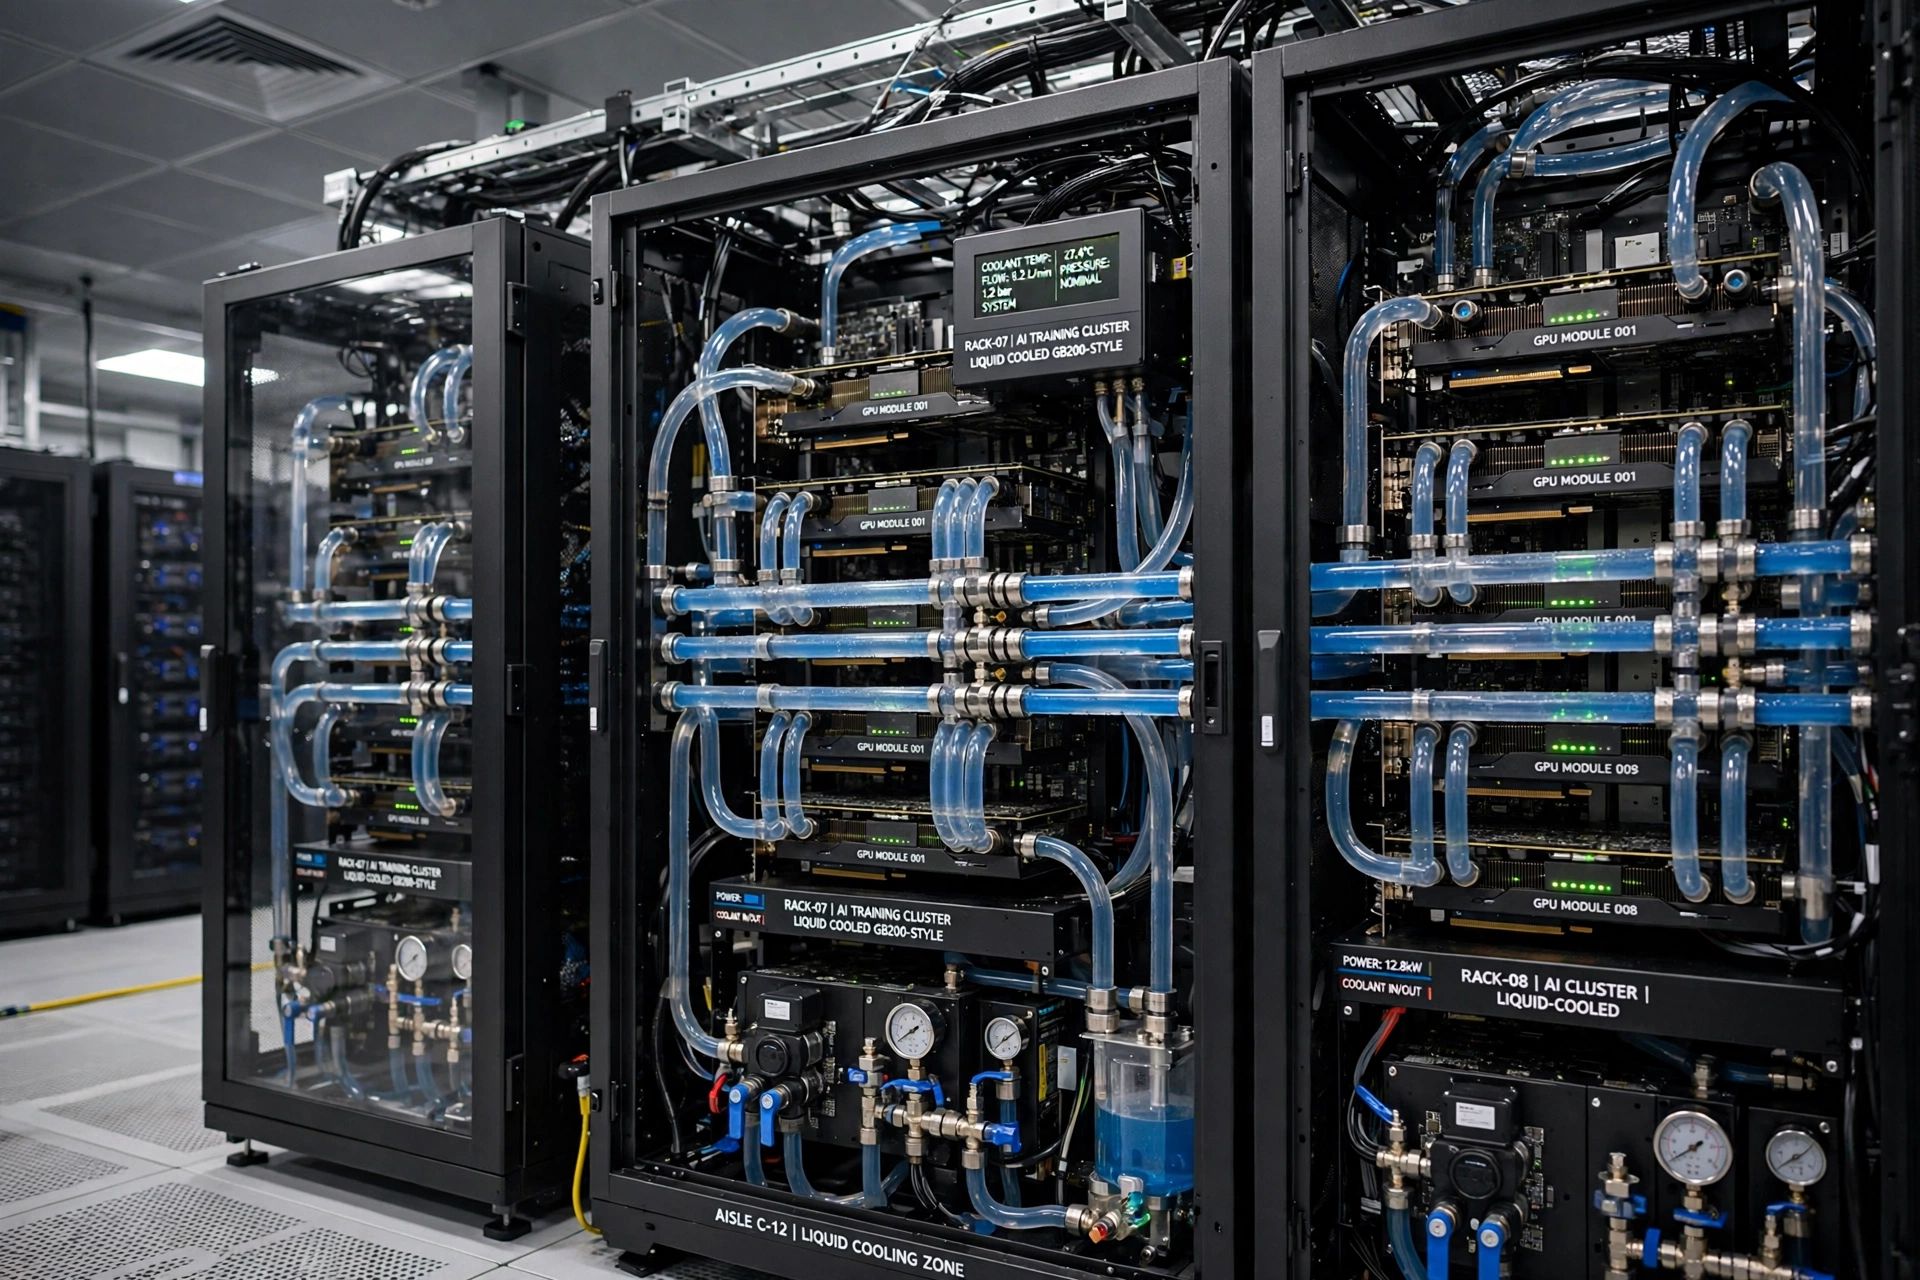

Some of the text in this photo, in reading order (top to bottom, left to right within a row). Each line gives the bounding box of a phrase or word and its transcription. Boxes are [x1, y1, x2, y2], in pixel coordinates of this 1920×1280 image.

[1063, 246, 1094, 260] 27.4°C
[981, 257, 1023, 272] COOLANT
[981, 272, 1010, 286] FLOW:
[1060, 272, 1102, 290] NOMINAL
[997, 285, 1012, 297] bar
[981, 298, 1016, 313] SYSTEM
[964, 335, 1009, 352] RACK-07
[1016, 334, 1028, 346] AI
[1029, 326, 1080, 344] TRAINING
[1081, 320, 1130, 337] CLUSTER
[1533, 325, 1637, 346] GPU MODULE 001
[970, 340, 1124, 370] LIQUID COOLED GB200-STYLE
[862, 400, 928, 416] GPU MODULE 001
[1533, 471, 1636, 488] GPU MODULE 001
[860, 517, 926, 530] GPU MODULE 001
[857, 742, 925, 754] GPU MODULE 001
[1534, 761, 1559, 773] GPU
[1562, 762, 1612, 775] MODULE
[857, 849, 926, 864] GPU MODULE 001
[784, 898, 828, 915] RACK-07
[836, 904, 848, 917] AI
[850, 904, 902, 922] TRAINING
[902, 908, 952, 926] CLUSTER
[1533, 898, 1638, 916] GPU MODULE 008
[793, 915, 944, 942] LIQUID COOLED GB200-STYLE
[1342, 955, 1423, 973] POWER: 12.8kW
[1342, 978, 1422, 997] COOLANT IN/OUT
[1460, 968, 1529, 990] RACK-08
[1544, 976, 1561, 992] AI
[1565, 978, 1638, 1002] CLUSTER
[1496, 991, 1620, 1018] LIQUID-COOLED
[714, 1208, 753, 1229] AISLE
[756, 1217, 788, 1238] C-12
[801, 1226, 849, 1250] LIQUID
[852, 1240, 919, 1268] COOLING
[922, 1254, 966, 1278] ZONE
